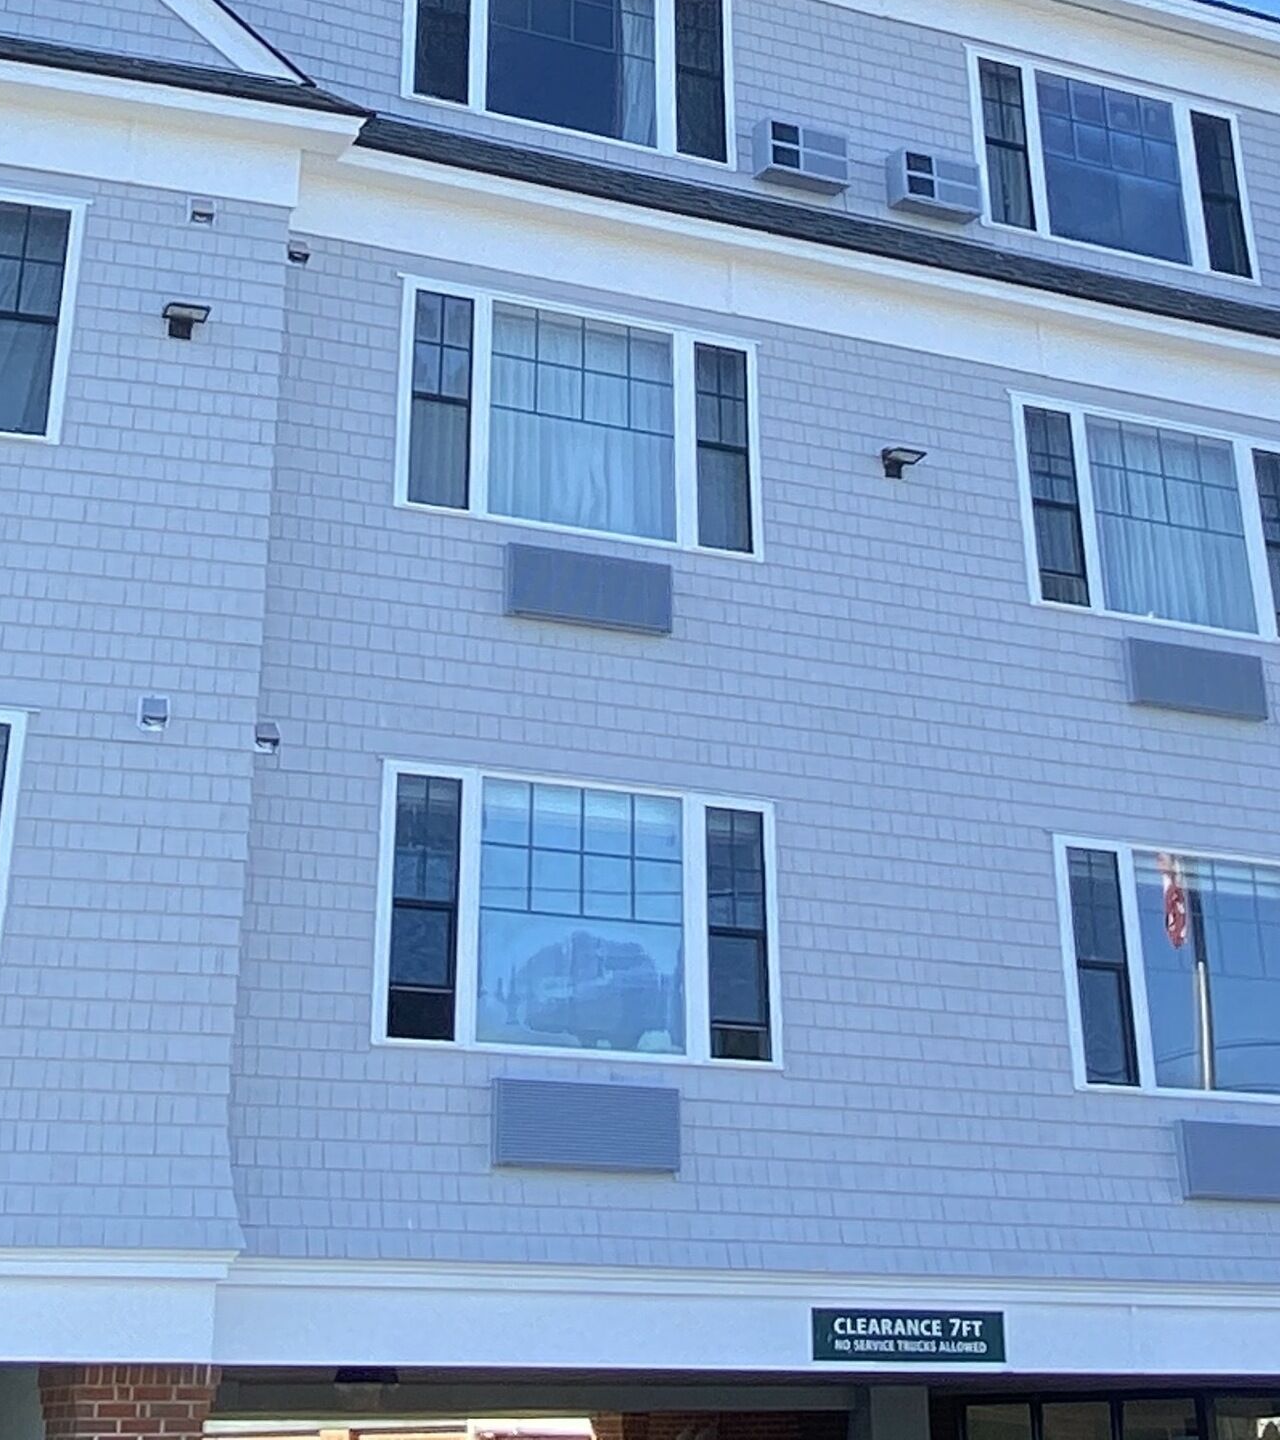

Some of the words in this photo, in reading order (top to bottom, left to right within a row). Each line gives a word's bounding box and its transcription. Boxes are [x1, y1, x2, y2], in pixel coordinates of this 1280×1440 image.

[833, 1317, 943, 1337] CLEARANCE
[949, 1318, 983, 1338] 7FT
[834, 1339, 850, 1351] NO
[853, 1339, 895, 1352] SERVICE
[897, 1340, 937, 1353] TRUCKS
[938, 1341, 987, 1354] ALLOWED
